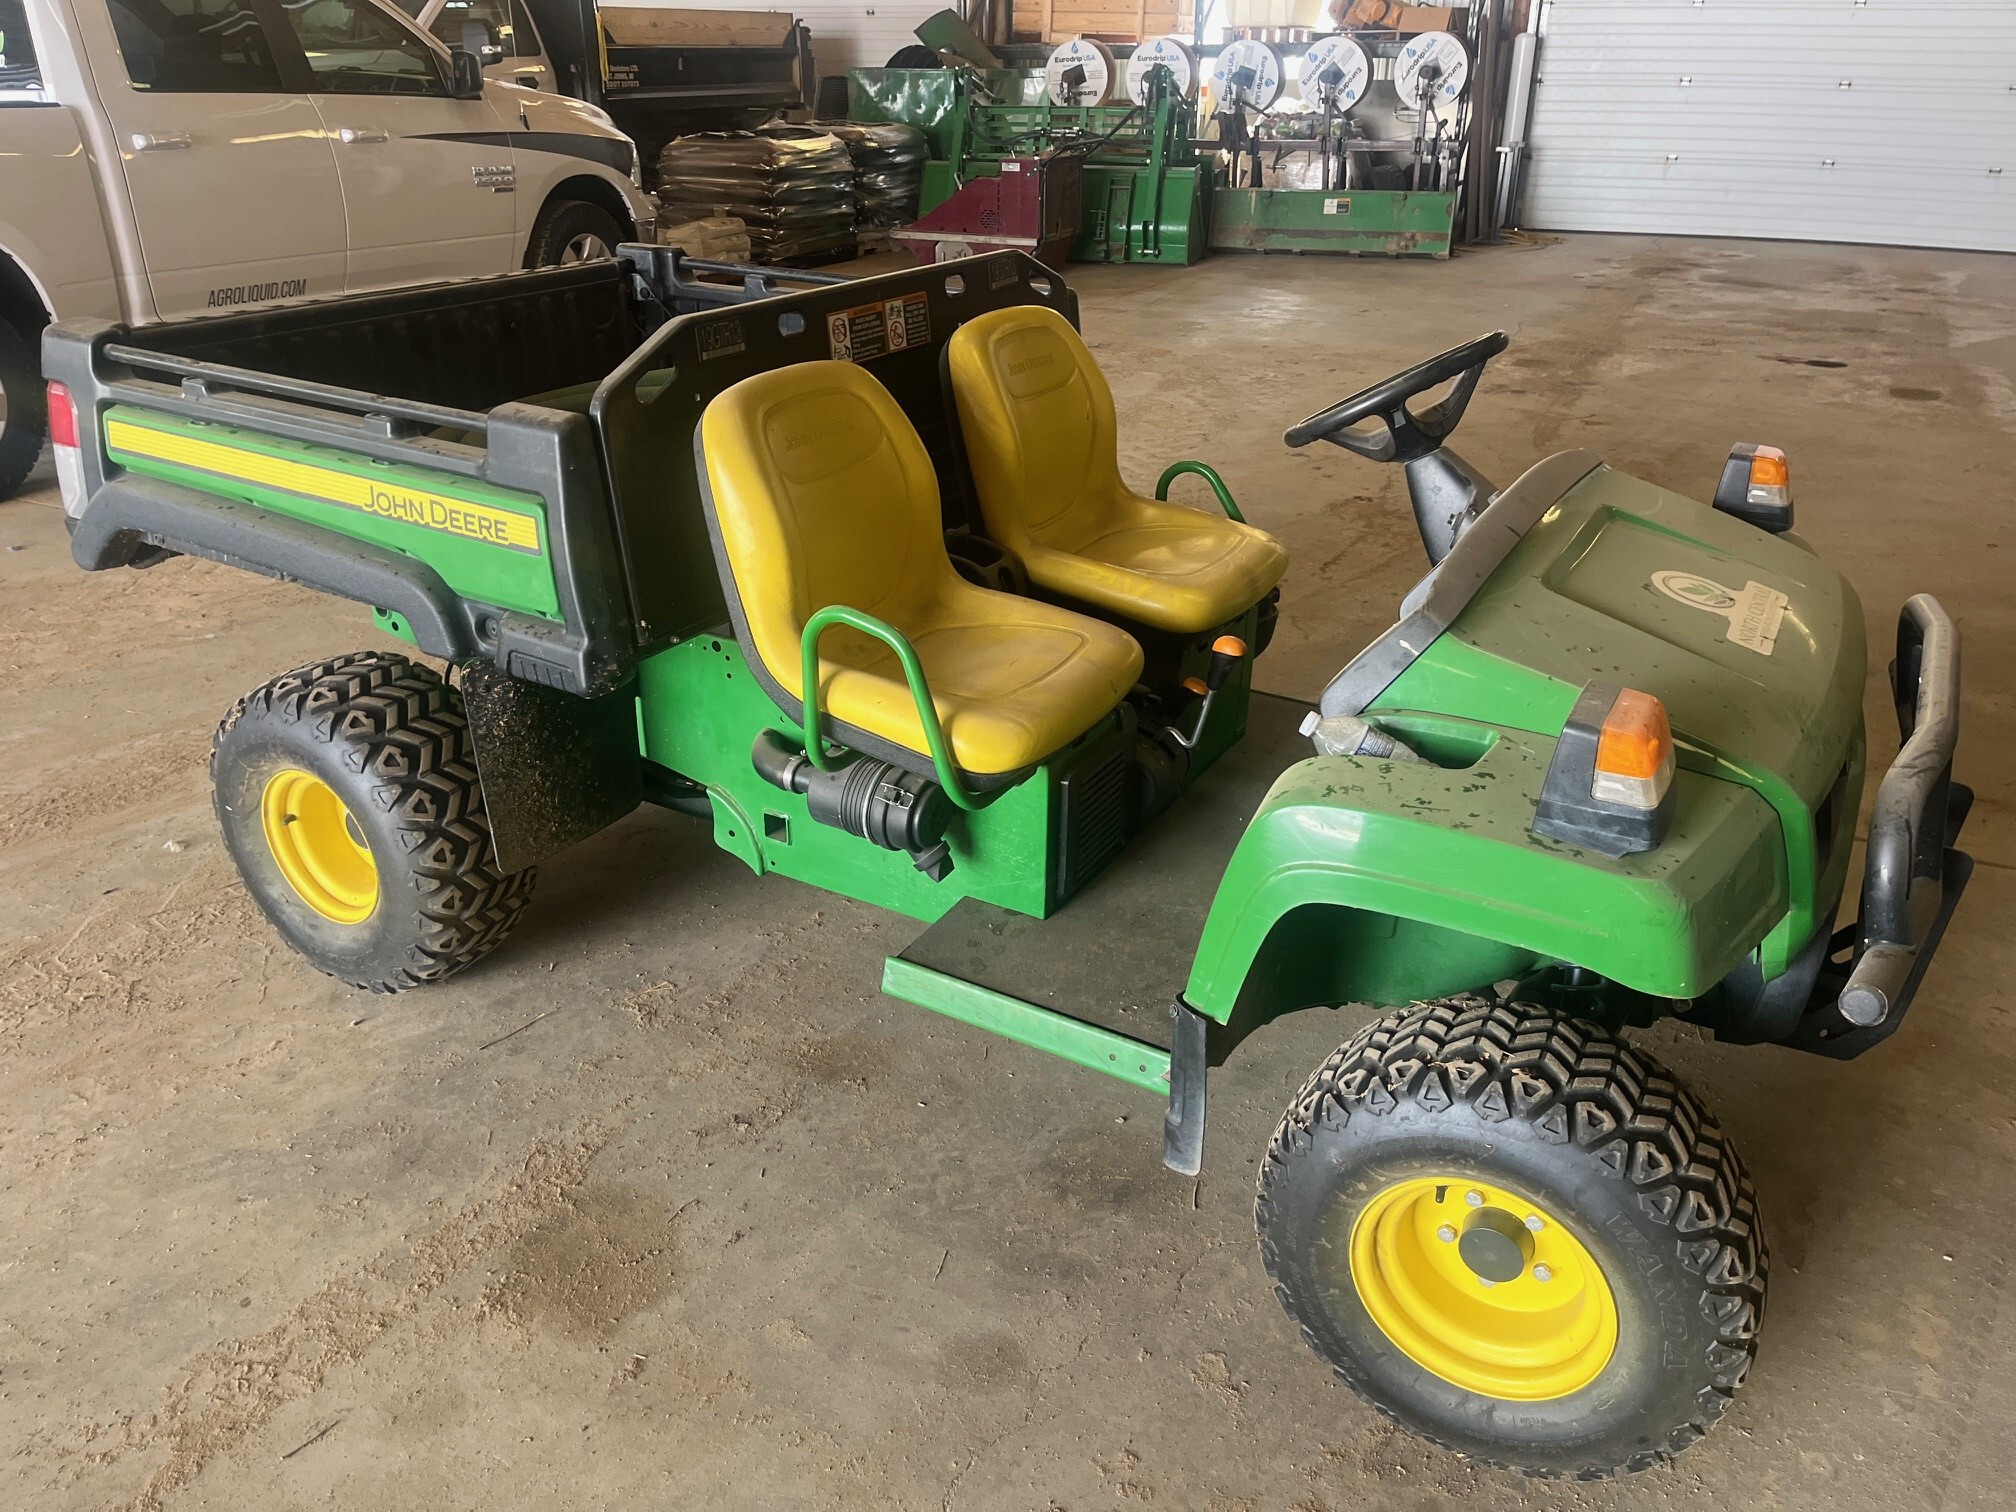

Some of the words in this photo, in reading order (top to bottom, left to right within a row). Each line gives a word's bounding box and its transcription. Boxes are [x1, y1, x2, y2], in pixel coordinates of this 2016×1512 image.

[1054, 55, 1083, 63] Eurodrip
[1228, 52, 1236, 67] USA
[1424, 38, 1438, 53] USA
[1256, 56, 1268, 90] Eurodrip
[1302, 57, 1327, 86] Eurodrip
[1325, 44, 1338, 58] USA
[1337, 67, 1362, 96] Eurodrip
[1254, 90, 1262, 105] USA
[207, 279, 307, 308] AGROLIQUID.COM
[364, 485, 425, 521] JOHN
[429, 499, 509, 541] DEERE
[1747, 585, 1772, 616] CENTRAL
[1738, 614, 1761, 646] NORTH
[1606, 1211, 1688, 1369] WANDA
